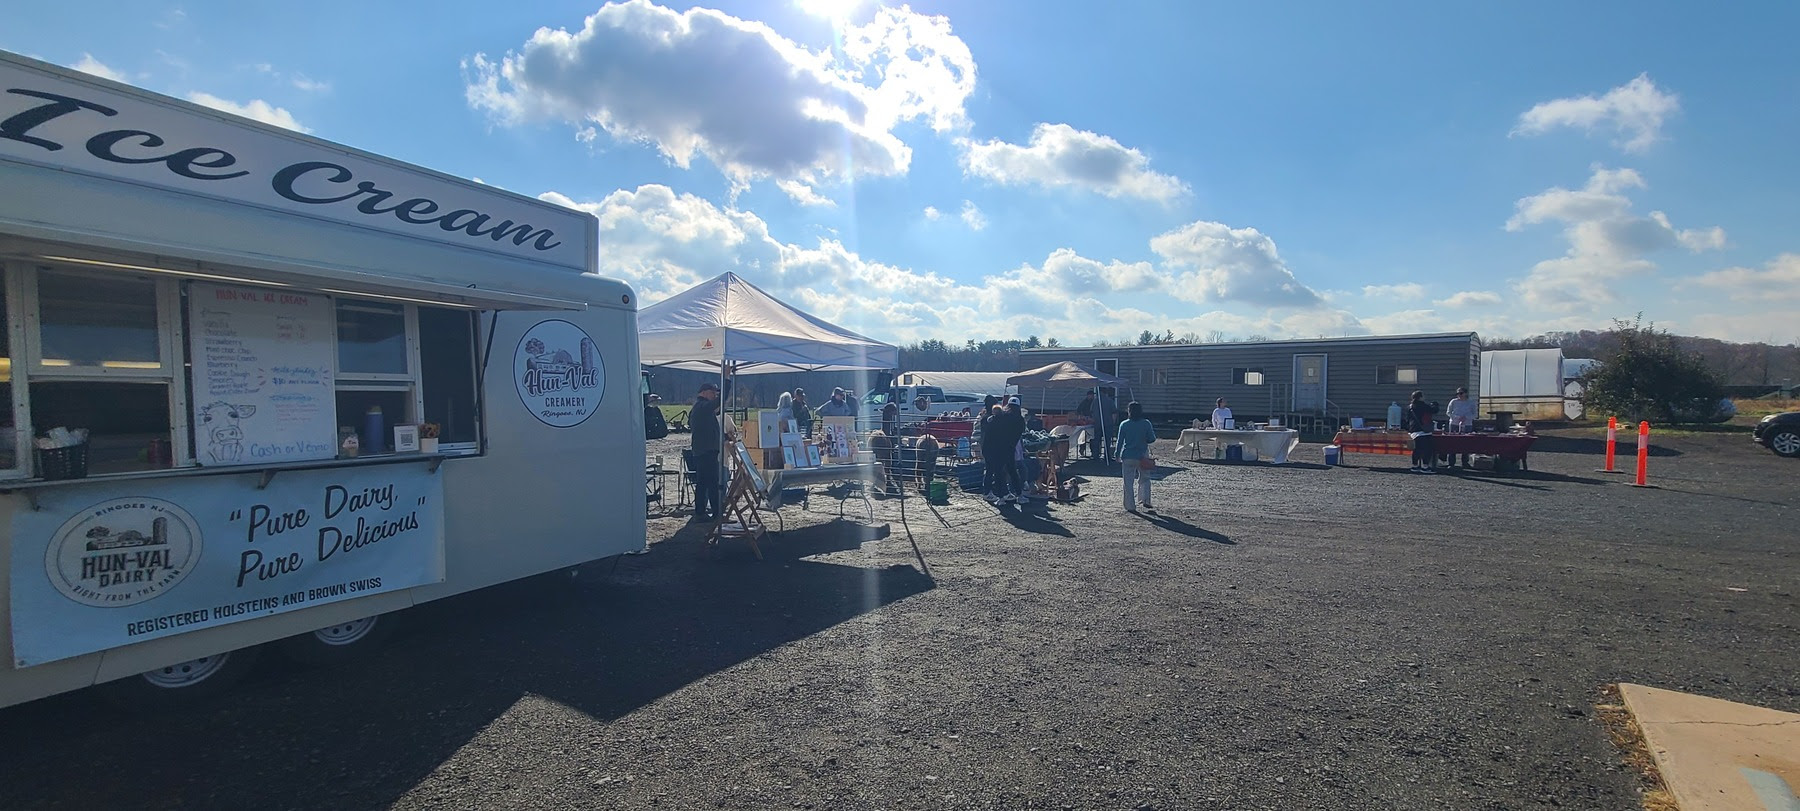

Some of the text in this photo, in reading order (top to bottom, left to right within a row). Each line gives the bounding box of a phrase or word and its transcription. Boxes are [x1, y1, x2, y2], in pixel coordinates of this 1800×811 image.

[0, 89, 561, 250] Ice Cream
[241, 292, 258, 302] VAL
[264, 292, 275, 303] ICE
[280, 294, 308, 305] CREAM
[523, 366, 599, 397] Hun-Val
[545, 397, 585, 407] CREAMERY
[251, 443, 282, 458] Cash
[286, 445, 295, 454] or
[96, 504, 165, 516] RINGOES NJ
[324, 483, 399, 520] Dairy,
[80, 549, 175, 581] HUN-VAL
[98, 568, 156, 589] DAIRY
[236, 550, 304, 587] Pure
[72, 570, 181, 602] RIGHT FROM THE FARM
[127, 577, 382, 636] REGISTERED HOLSTEINS AND BROWN SWISS
